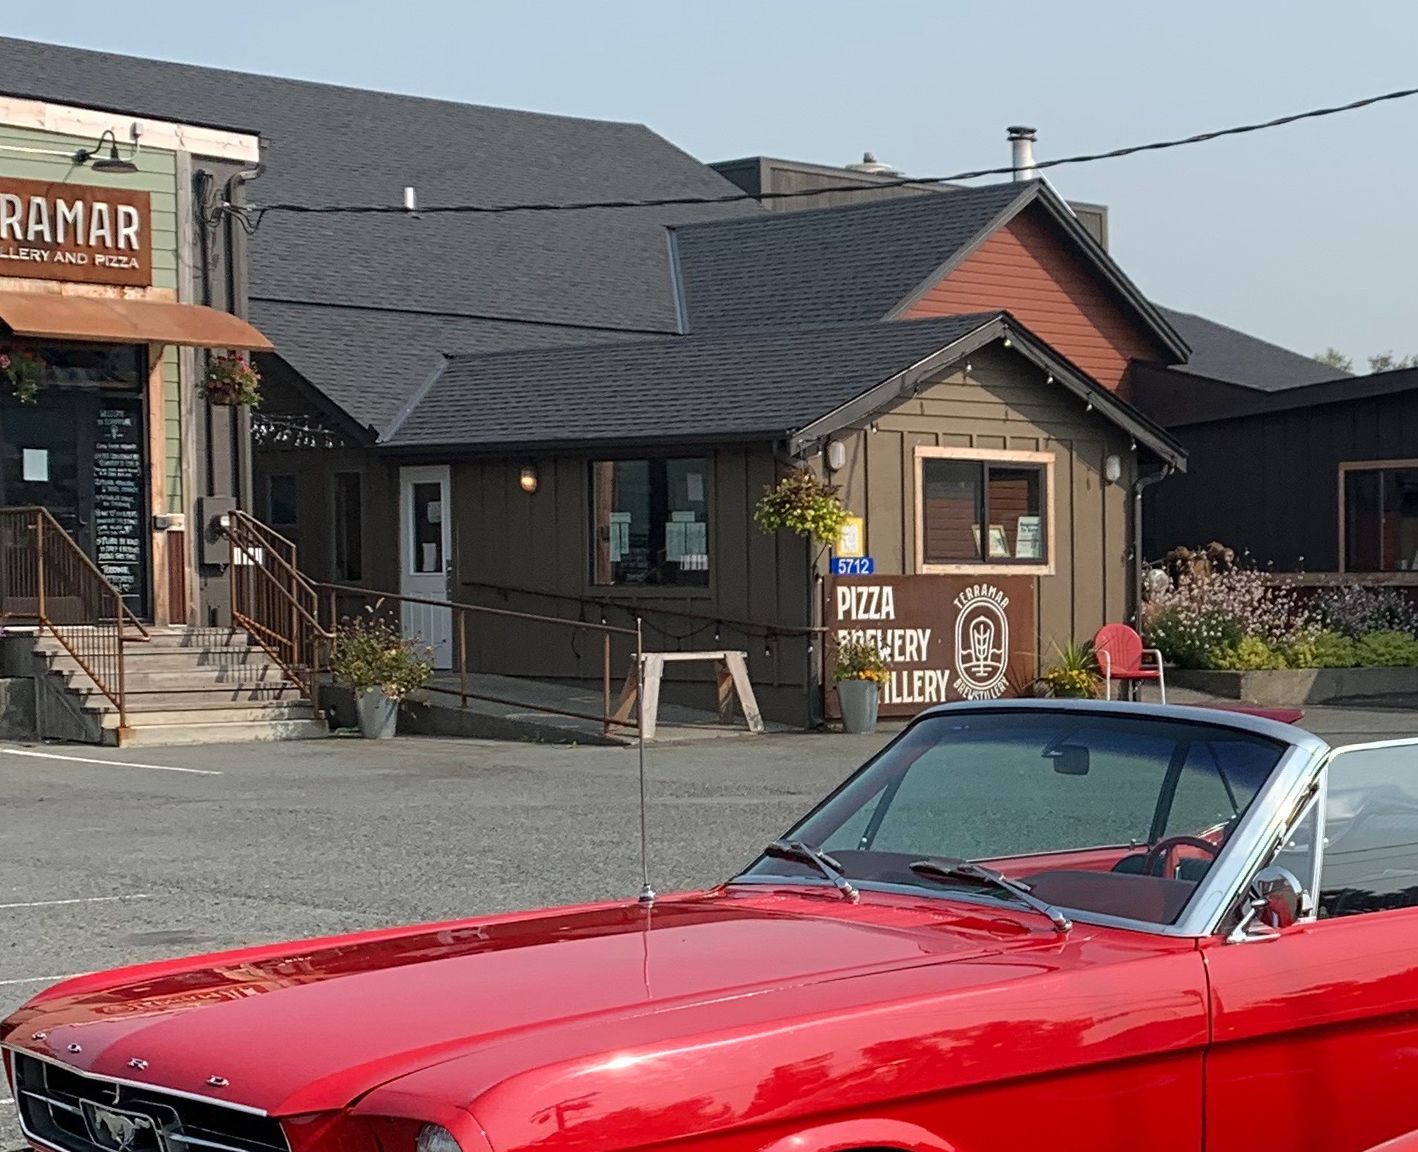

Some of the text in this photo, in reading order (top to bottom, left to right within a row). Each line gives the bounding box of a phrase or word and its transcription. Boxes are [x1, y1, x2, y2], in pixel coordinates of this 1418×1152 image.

[54, 251, 88, 265] AND
[94, 254, 139, 269] PIZZA
[838, 558, 870, 574] 5712
[836, 585, 895, 620] PIZZA
[953, 583, 1010, 609] TERRAMAR
